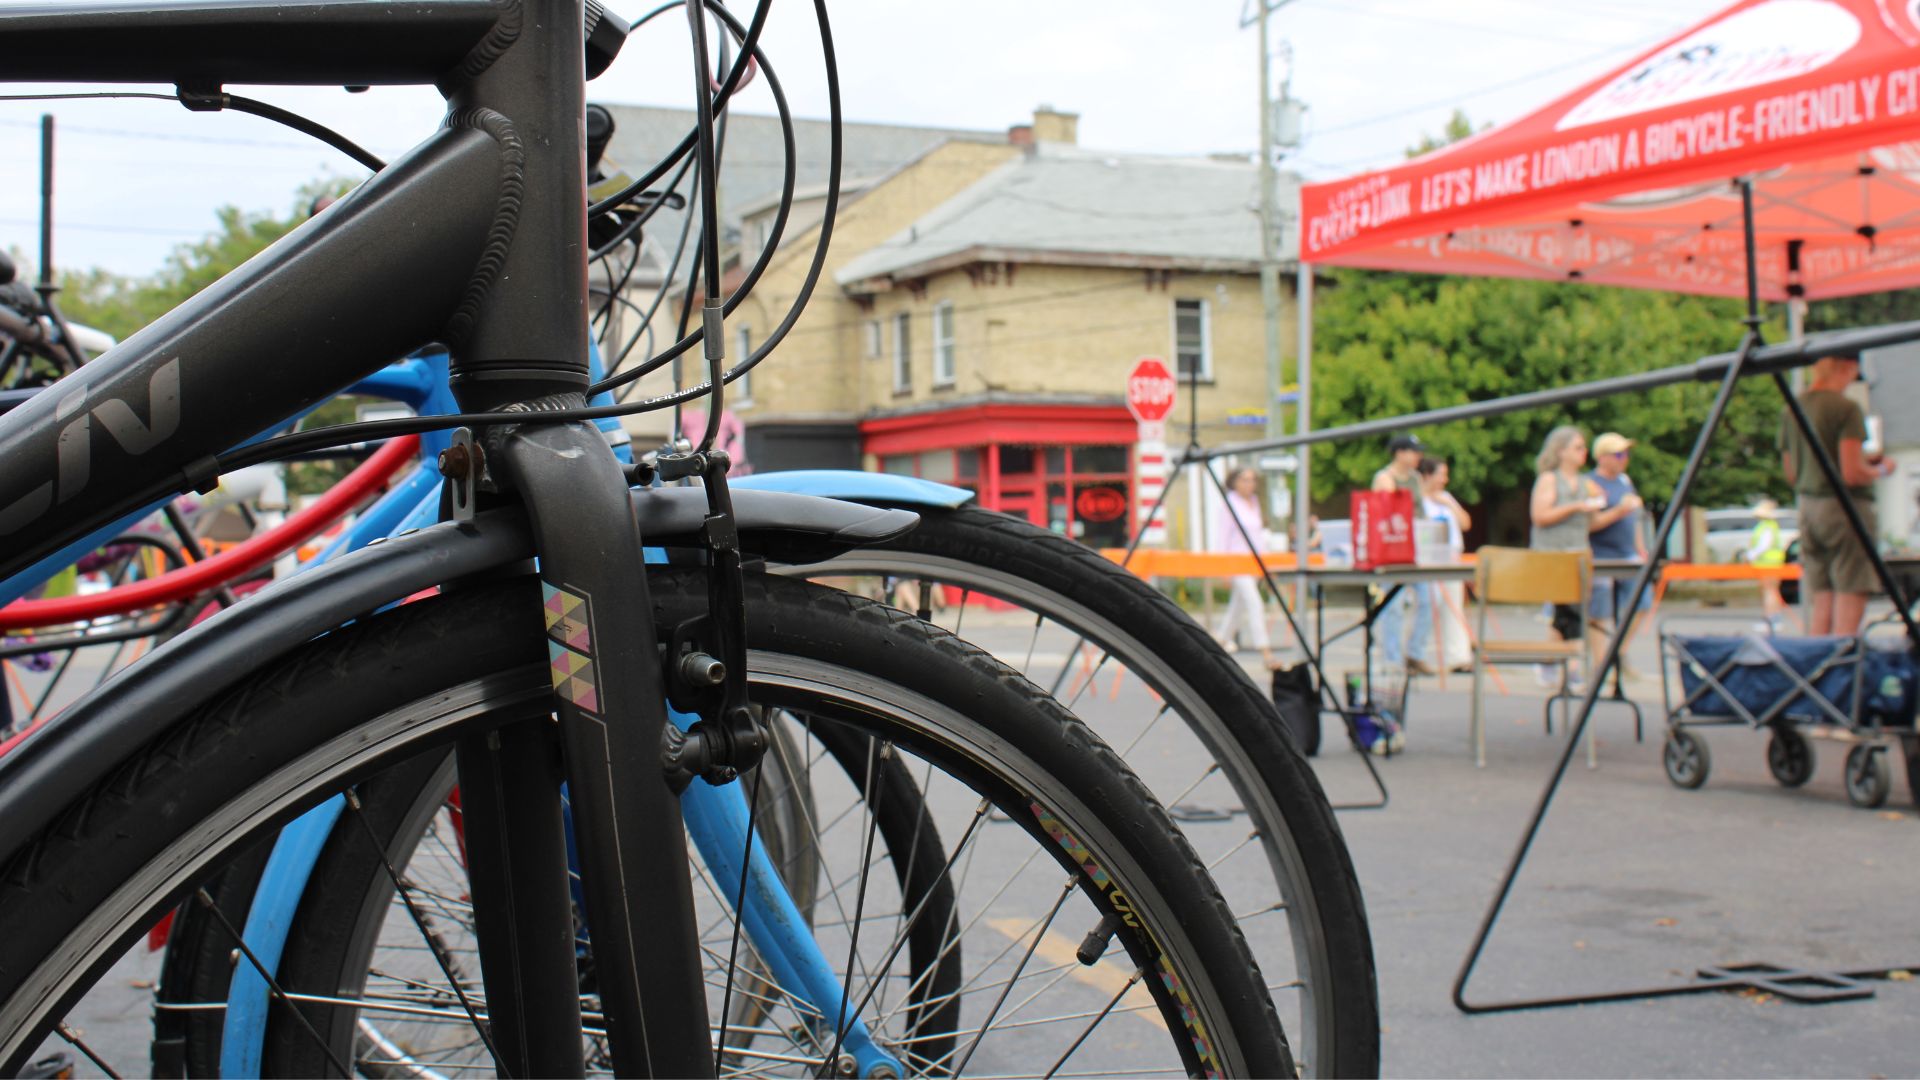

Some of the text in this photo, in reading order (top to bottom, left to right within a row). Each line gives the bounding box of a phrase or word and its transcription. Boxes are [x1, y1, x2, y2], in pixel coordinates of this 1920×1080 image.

[1421, 167, 1472, 213] LET'S
[1474, 153, 1528, 200] MAKE
[1531, 133, 1621, 189] LONDON
[1623, 129, 1640, 170] A
[1644, 75, 1881, 165] BICYCLE-FRIENDLY
[1887, 66, 1920, 116] CI
[1129, 376, 1175, 404] STOP
